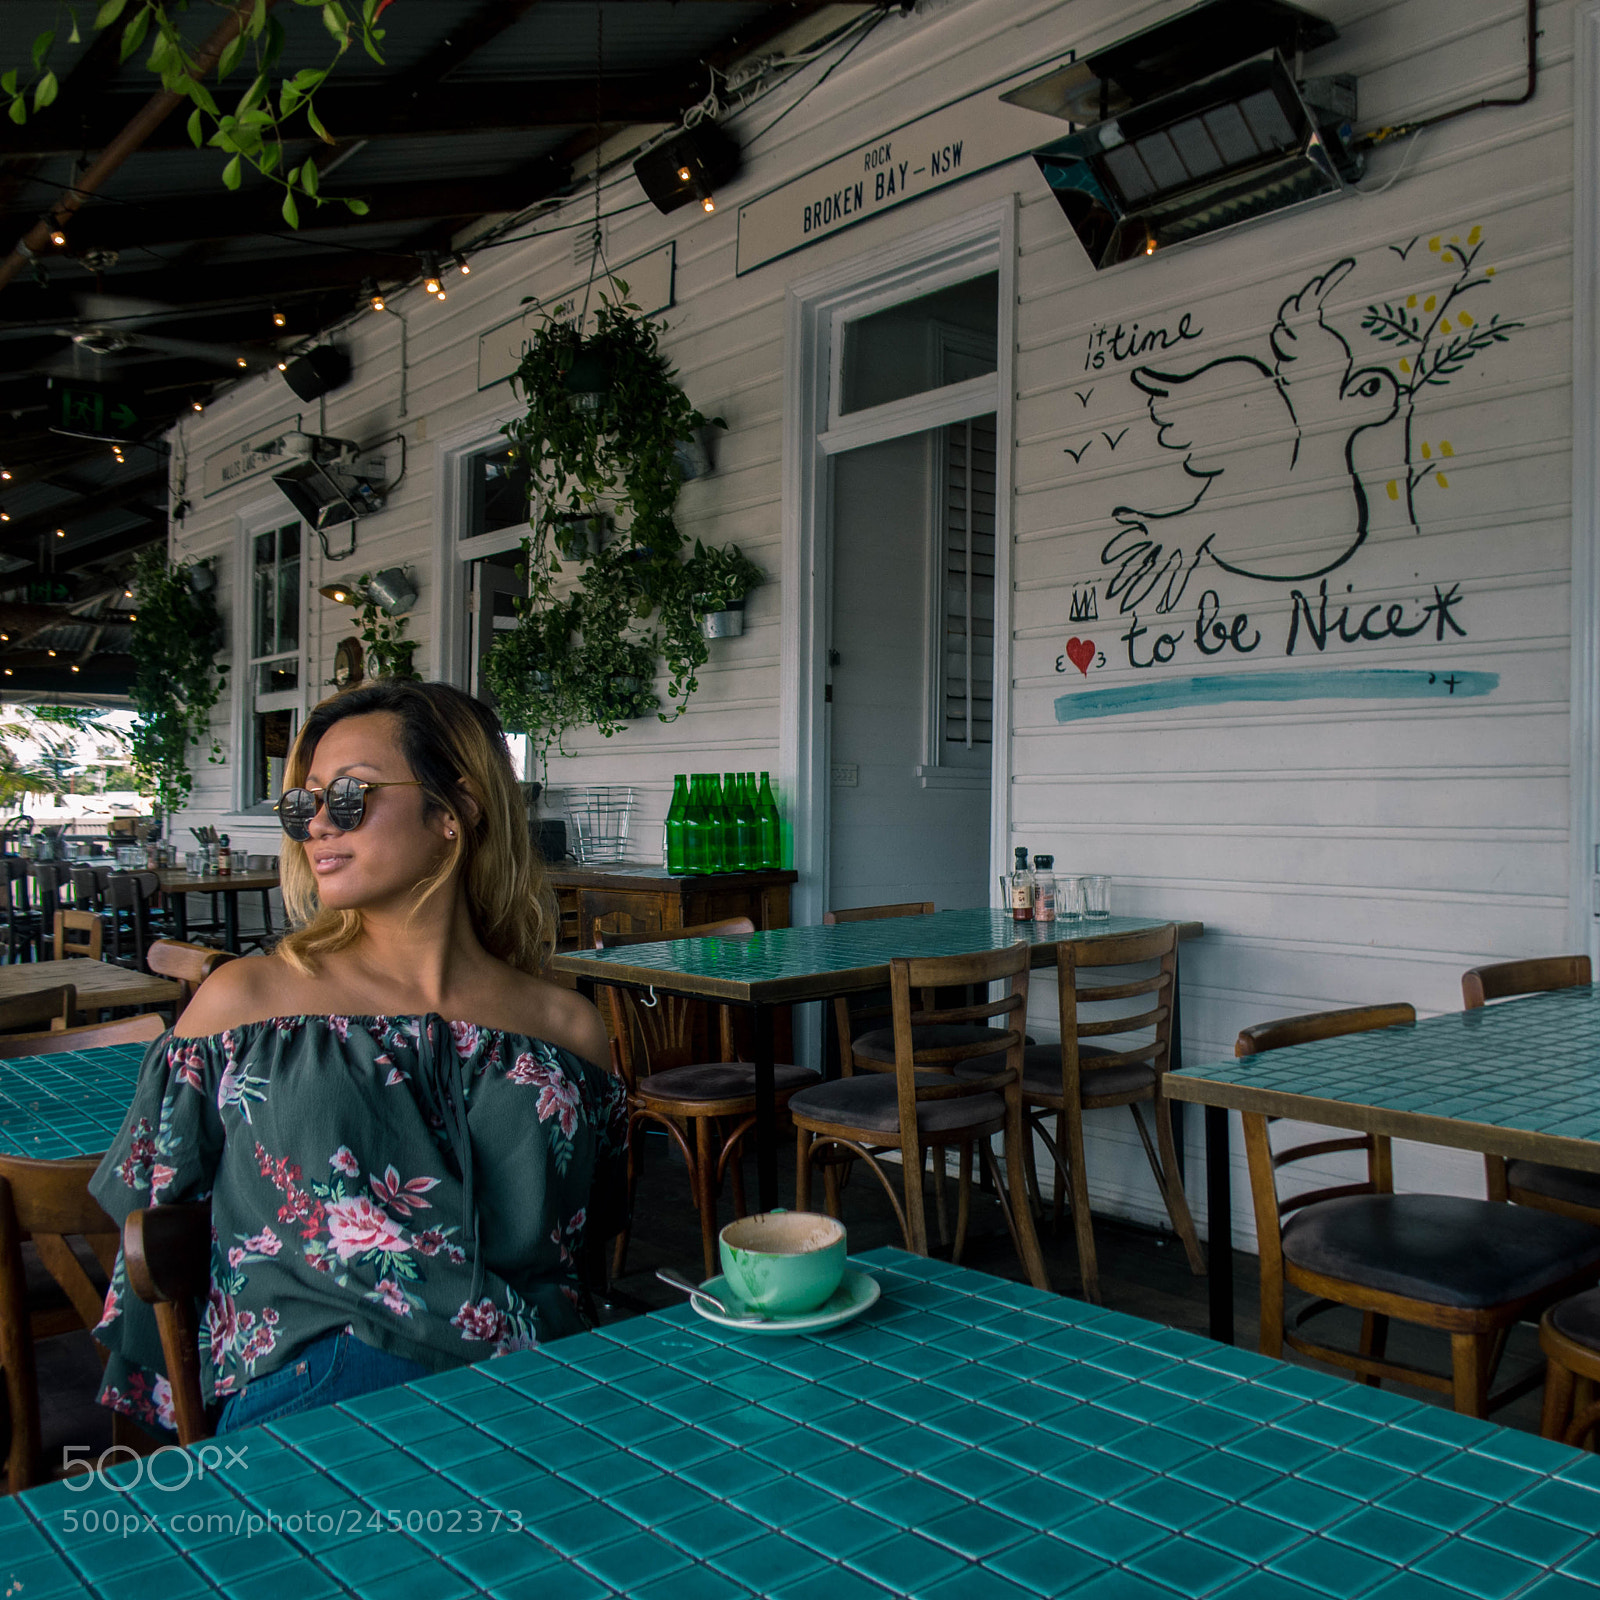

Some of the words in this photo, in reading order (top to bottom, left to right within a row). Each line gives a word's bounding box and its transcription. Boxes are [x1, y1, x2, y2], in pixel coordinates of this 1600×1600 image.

[864, 142, 892, 172] ROCK
[803, 181, 864, 234] BROKEN
[875, 160, 909, 202] BAY
[931, 140, 964, 178] NSW
[1088, 322, 1107, 350] it
[1107, 312, 1204, 361] time
[1084, 351, 1106, 371] is
[1121, 610, 1184, 669] to
[1194, 589, 1261, 655] be
